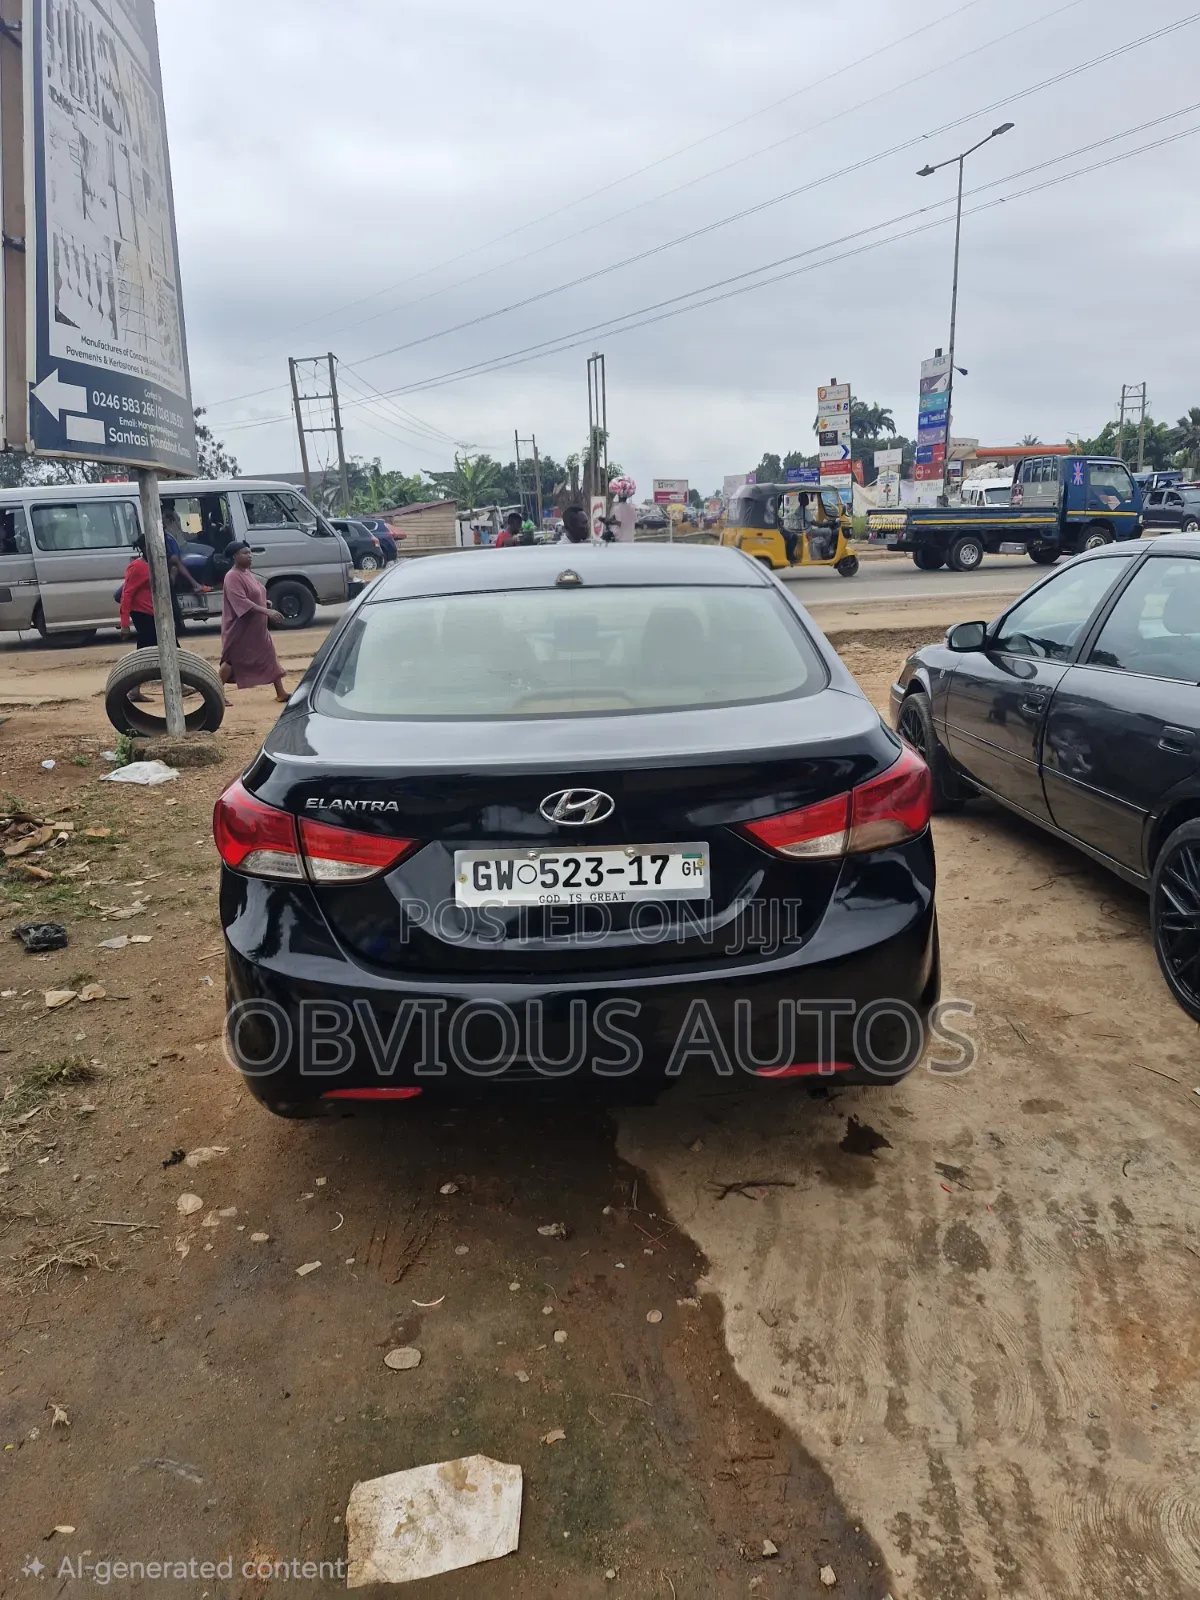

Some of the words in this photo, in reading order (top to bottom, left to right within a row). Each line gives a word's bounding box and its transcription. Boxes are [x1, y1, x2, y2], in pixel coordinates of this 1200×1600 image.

[66, 345, 102, 364] Pavements
[103, 355, 108, 364] &
[92, 390, 120, 410] 0246
[121, 396, 141, 414] 583
[119, 416, 137, 428] Email:
[109, 427, 149, 447] Santasi
[305, 797, 399, 812] ELANTRA
[472, 860, 514, 892] GW
[539, 854, 670, 889] 523-17
[681, 860, 703, 877] GH
[538, 894, 560, 904] GOD
[569, 893, 582, 903] IS
[589, 892, 627, 903] GREAT
